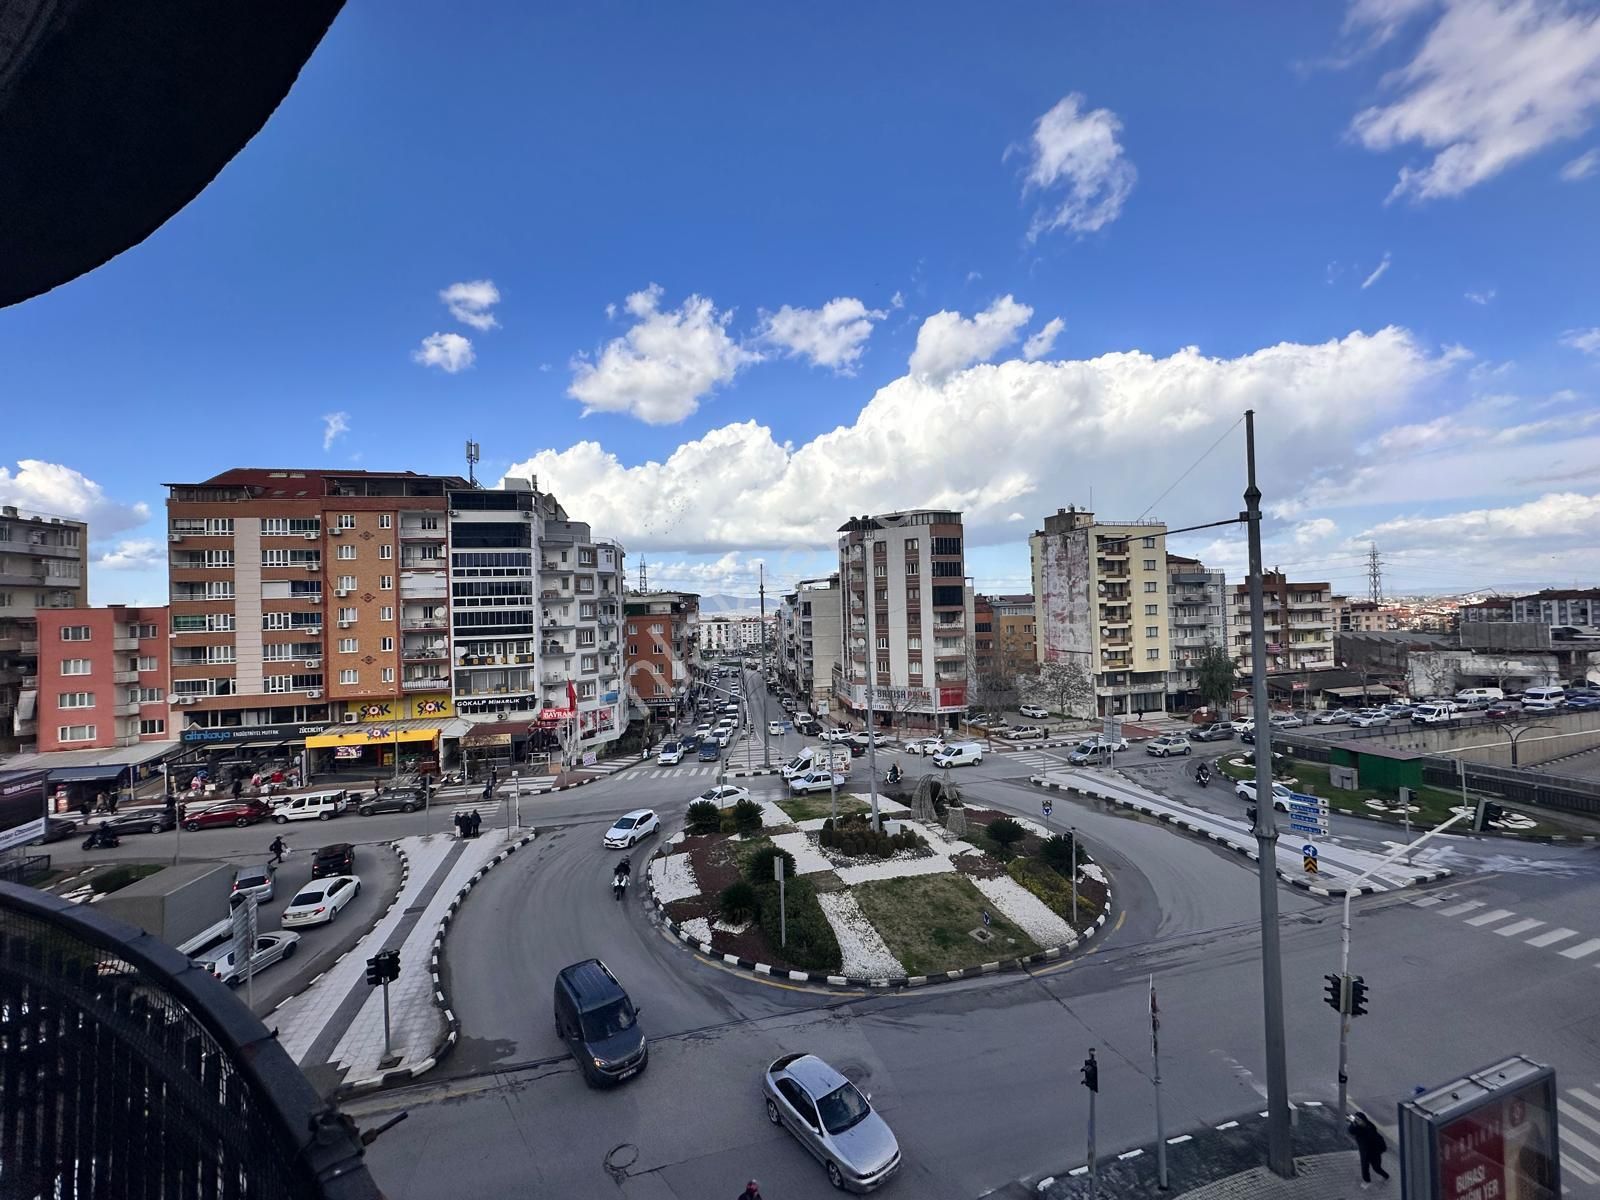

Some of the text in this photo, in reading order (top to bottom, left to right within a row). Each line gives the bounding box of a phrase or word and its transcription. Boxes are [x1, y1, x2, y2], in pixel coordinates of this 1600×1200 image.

[877, 689, 906, 699] BRITISH
[360, 703, 391, 719] ŞOK
[417, 700, 447, 716] ŞOK
[1482, 1178, 1499, 1200] YER
